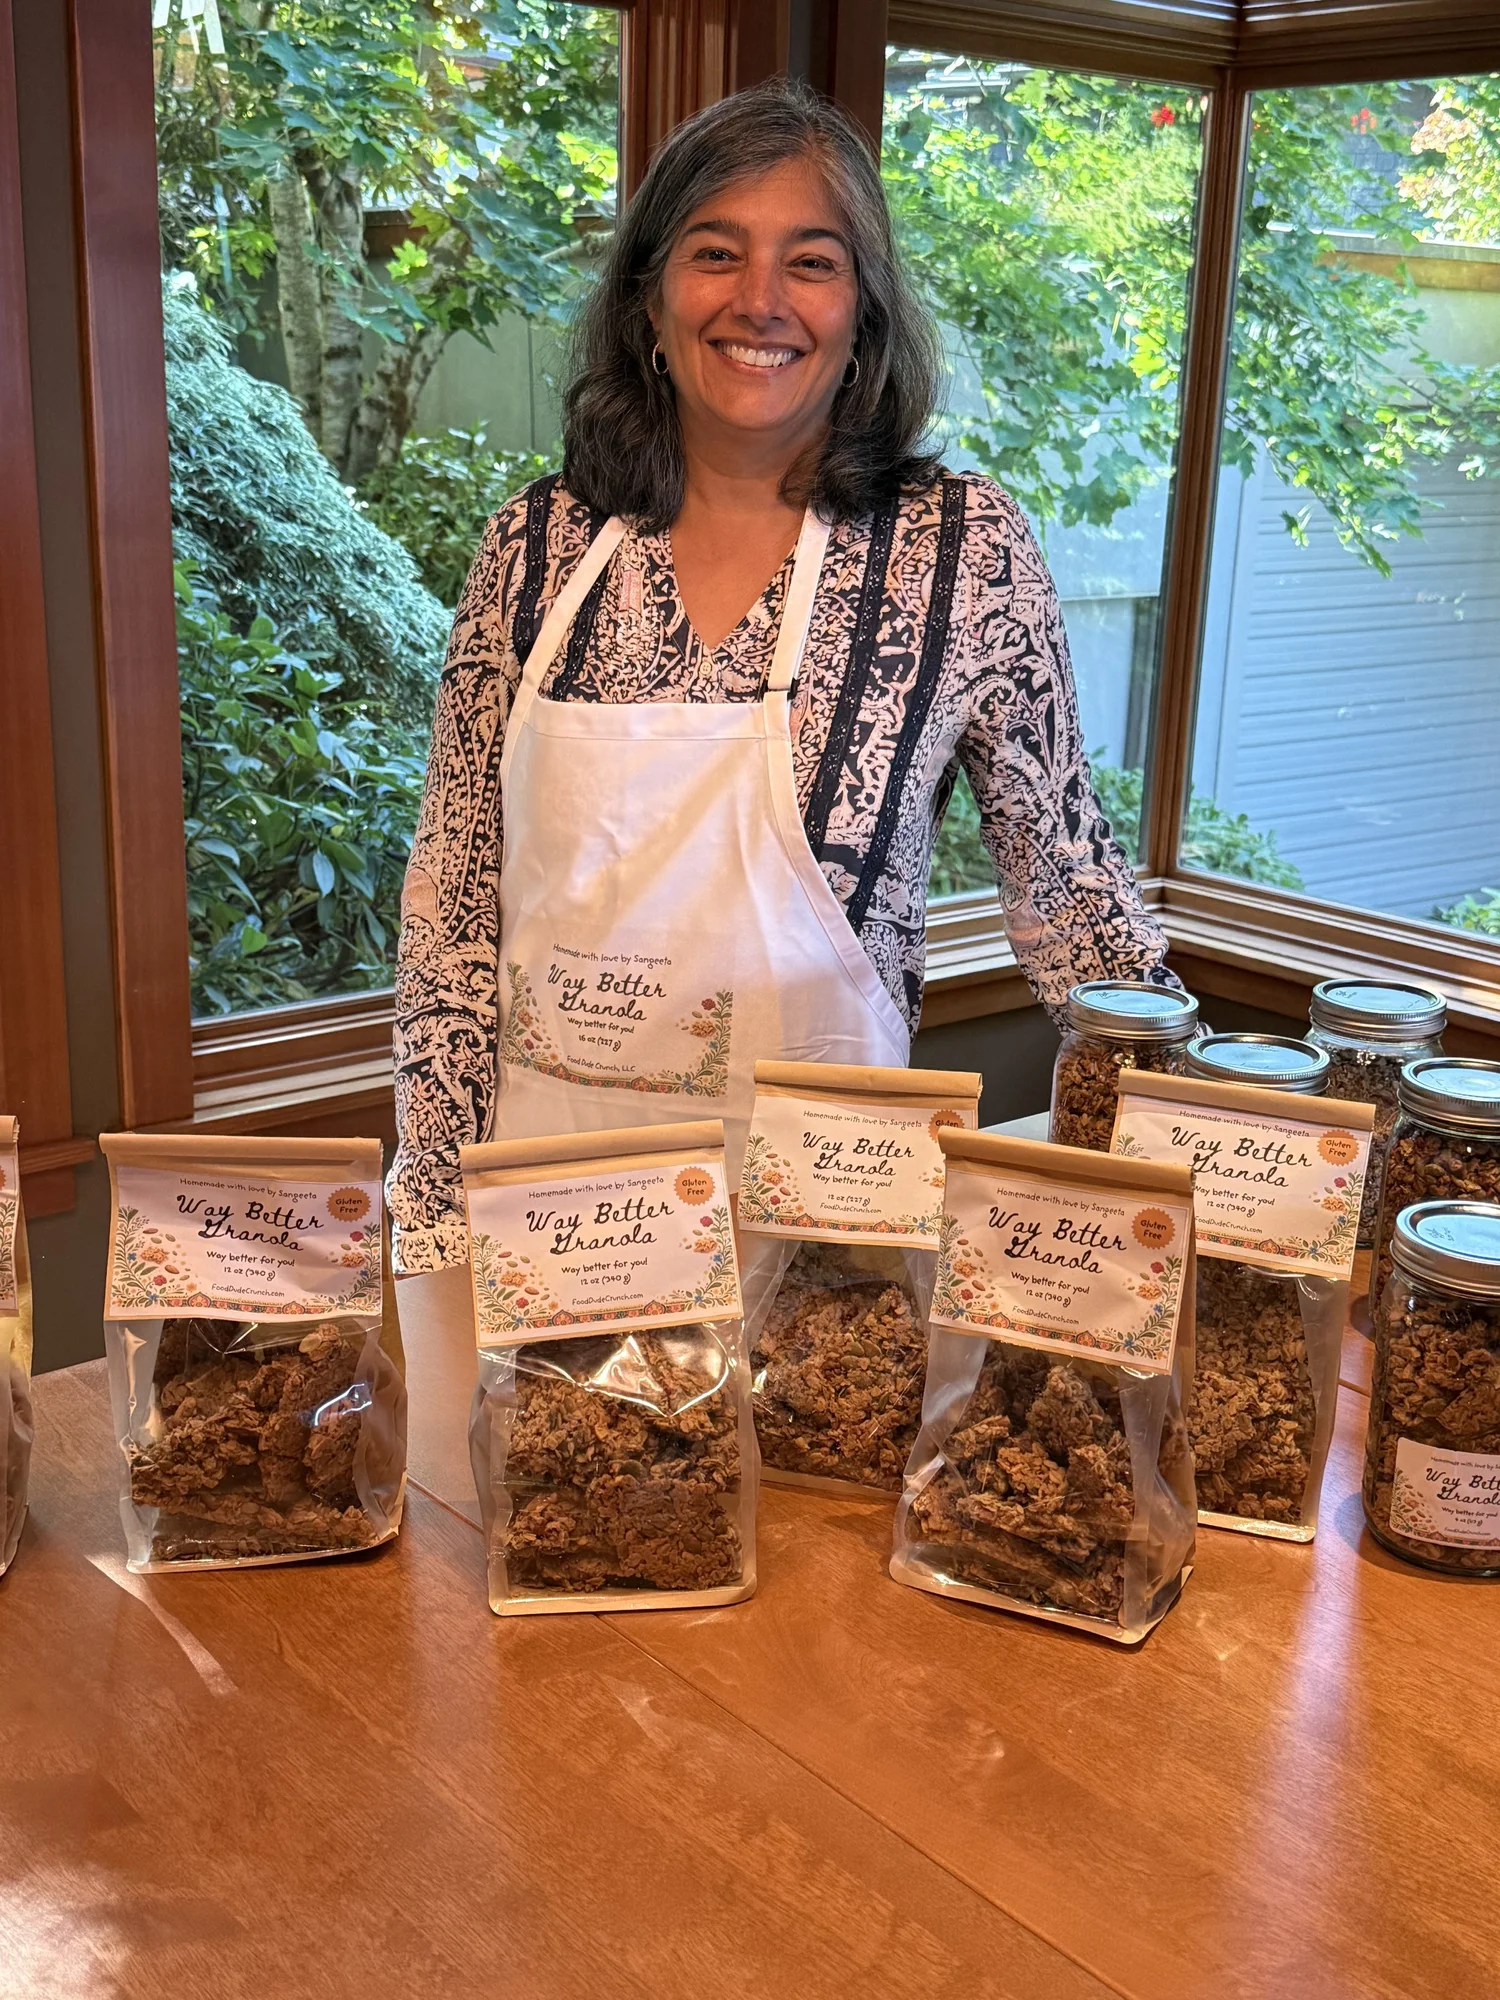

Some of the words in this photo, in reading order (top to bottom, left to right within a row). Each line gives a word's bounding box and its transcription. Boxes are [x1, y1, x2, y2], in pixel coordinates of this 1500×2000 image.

[552, 943, 580, 958] Homemade
[581, 952, 598, 961] with
[600, 953, 619, 962] love
[620, 953, 632, 965] by
[547, 963, 588, 996] Way
[596, 971, 667, 998] Better
[557, 991, 647, 1021] Granola
[567, 1017, 583, 1028] Way
[584, 1019, 607, 1029] better
[608, 1022, 620, 1031] for
[620, 1026, 635, 1034] you!
[612, 1040, 622, 1052] g)
[566, 1055, 581, 1065] Food
[581, 1058, 594, 1069] Dude
[594, 1062, 620, 1072] Crunch,
[803, 1110, 843, 1121] Homemade
[844, 1115, 861, 1123] with
[862, 1117, 878, 1125] love
[879, 1118, 889, 1128] by
[1179, 1110, 1222, 1122] Homemade
[1223, 1118, 1241, 1126] with
[1243, 1121, 1260, 1129] love
[1261, 1123, 1272, 1133] by
[1273, 1125, 1310, 1138] Sangeeta
[802, 1131, 844, 1156] Way
[852, 1138, 915, 1158] Better
[1171, 1126, 1223, 1158] Way
[1233, 1137, 1313, 1167] Better
[1325, 1139, 1352, 1149] Gluten
[1328, 1147, 1347, 1158] Free
[813, 1152, 897, 1176] Granola
[1187, 1152, 1290, 1188] Granola
[180, 1178, 225, 1189] Homemade
[227, 1183, 247, 1191] with
[248, 1185, 266, 1193] love
[267, 1187, 277, 1198] by
[278, 1189, 317, 1203] Sangeeta
[528, 1187, 573, 1199] Homemade
[574, 1184, 594, 1193] with
[596, 1183, 613, 1192] love
[614, 1181, 625, 1191] by
[627, 1176, 664, 1190] Sangeeta
[681, 1179, 707, 1188] Gluten
[812, 1172, 831, 1185] Way
[832, 1175, 859, 1185] better
[860, 1178, 875, 1187] for
[875, 1180, 893, 1190] you!
[686, 1188, 705, 1196] Free
[1212, 1187, 1240, 1199] better
[1241, 1193, 1257, 1202] for
[1257, 1198, 1276, 1206] you!
[176, 1194, 235, 1222] Way
[245, 1200, 324, 1230] Better
[819, 1202, 882, 1214] FoodDudeCrunch.com
[862, 1197, 871, 1208] g)
[996, 1187, 1041, 1202] Homemade
[1042, 1195, 1061, 1205] with
[1062, 1198, 1079, 1208] love
[1080, 1201, 1090, 1212] by
[1091, 1203, 1125, 1218] Sangeeta
[1226, 1203, 1246, 1213] (340
[1246, 1207, 1256, 1218] g)
[526, 1210, 583, 1233] Way
[593, 1196, 675, 1224] Better
[198, 1218, 304, 1251] Granola
[988, 1206, 1043, 1241] Way
[1052, 1218, 1127, 1251] Better
[1140, 1219, 1167, 1231] Gluten
[1143, 1229, 1162, 1240] Free
[549, 1222, 658, 1256] Granola
[206, 1250, 227, 1263] Way
[229, 1252, 258, 1264] better
[259, 1255, 275, 1265] for
[276, 1259, 295, 1268] you!
[1004, 1236, 1103, 1274] Granola
[245, 1268, 266, 1277] (340
[266, 1270, 276, 1282] g)
[561, 1266, 581, 1276] Way
[582, 1262, 611, 1273] better
[612, 1259, 628, 1269] for
[629, 1257, 648, 1270] you!
[601, 1275, 622, 1285] (340
[623, 1273, 632, 1286] g)
[1011, 1271, 1030, 1285] Way
[1031, 1275, 1056, 1287] better
[1057, 1280, 1071, 1290] for
[1072, 1286, 1090, 1295] you!
[211, 1283, 285, 1297] FoodDudeCrunch.com
[571, 1293, 644, 1306] FoodDudeCrunch.com
[1044, 1292, 1063, 1302] (340
[1062, 1296, 1072, 1308] g)
[1012, 1305, 1080, 1325] FoodDudeCrunch.com
[1426, 1467, 1462, 1491] Way
[1441, 1506, 1455, 1515] Way
